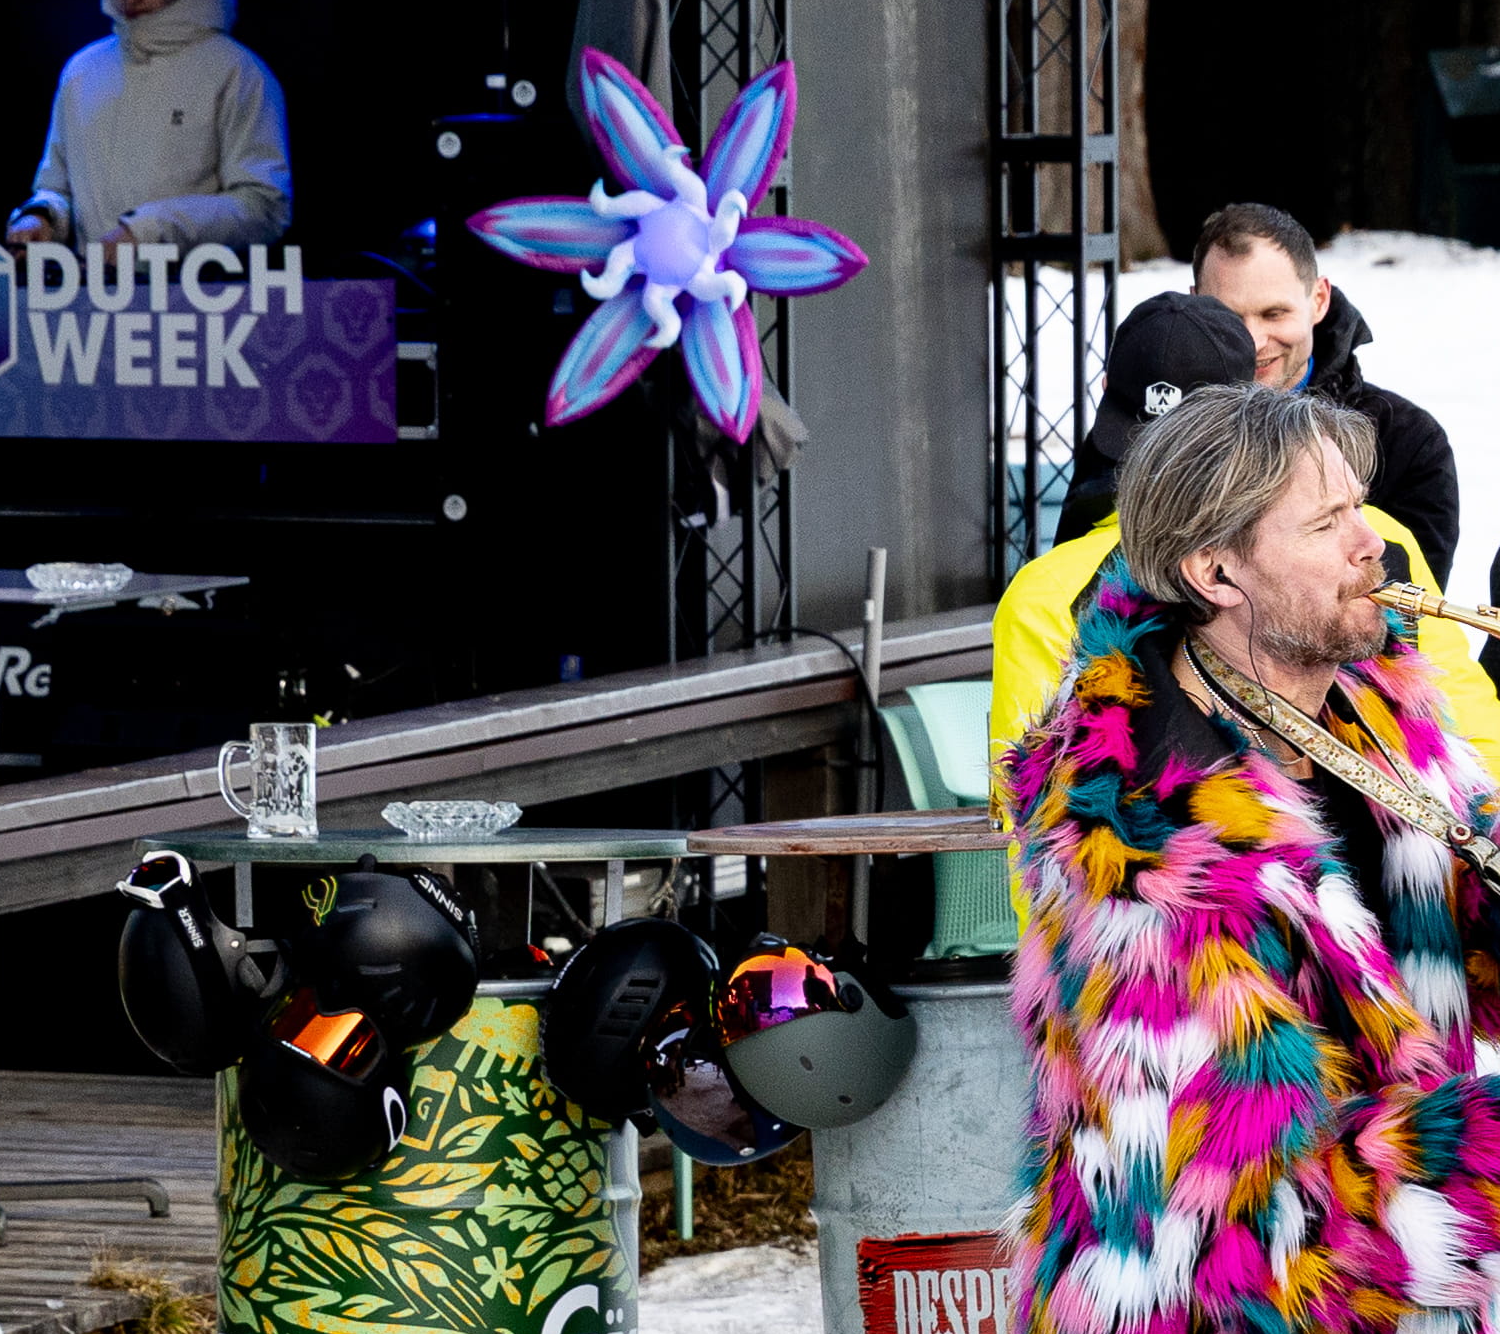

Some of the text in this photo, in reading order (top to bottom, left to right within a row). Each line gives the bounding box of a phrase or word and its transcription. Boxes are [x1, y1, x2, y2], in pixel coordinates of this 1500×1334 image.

[26, 242, 303, 314] DUTCH
[28, 313, 262, 388] WEEK
[178, 906, 205, 950] SINNER
[413, 873, 465, 923] SINNE
